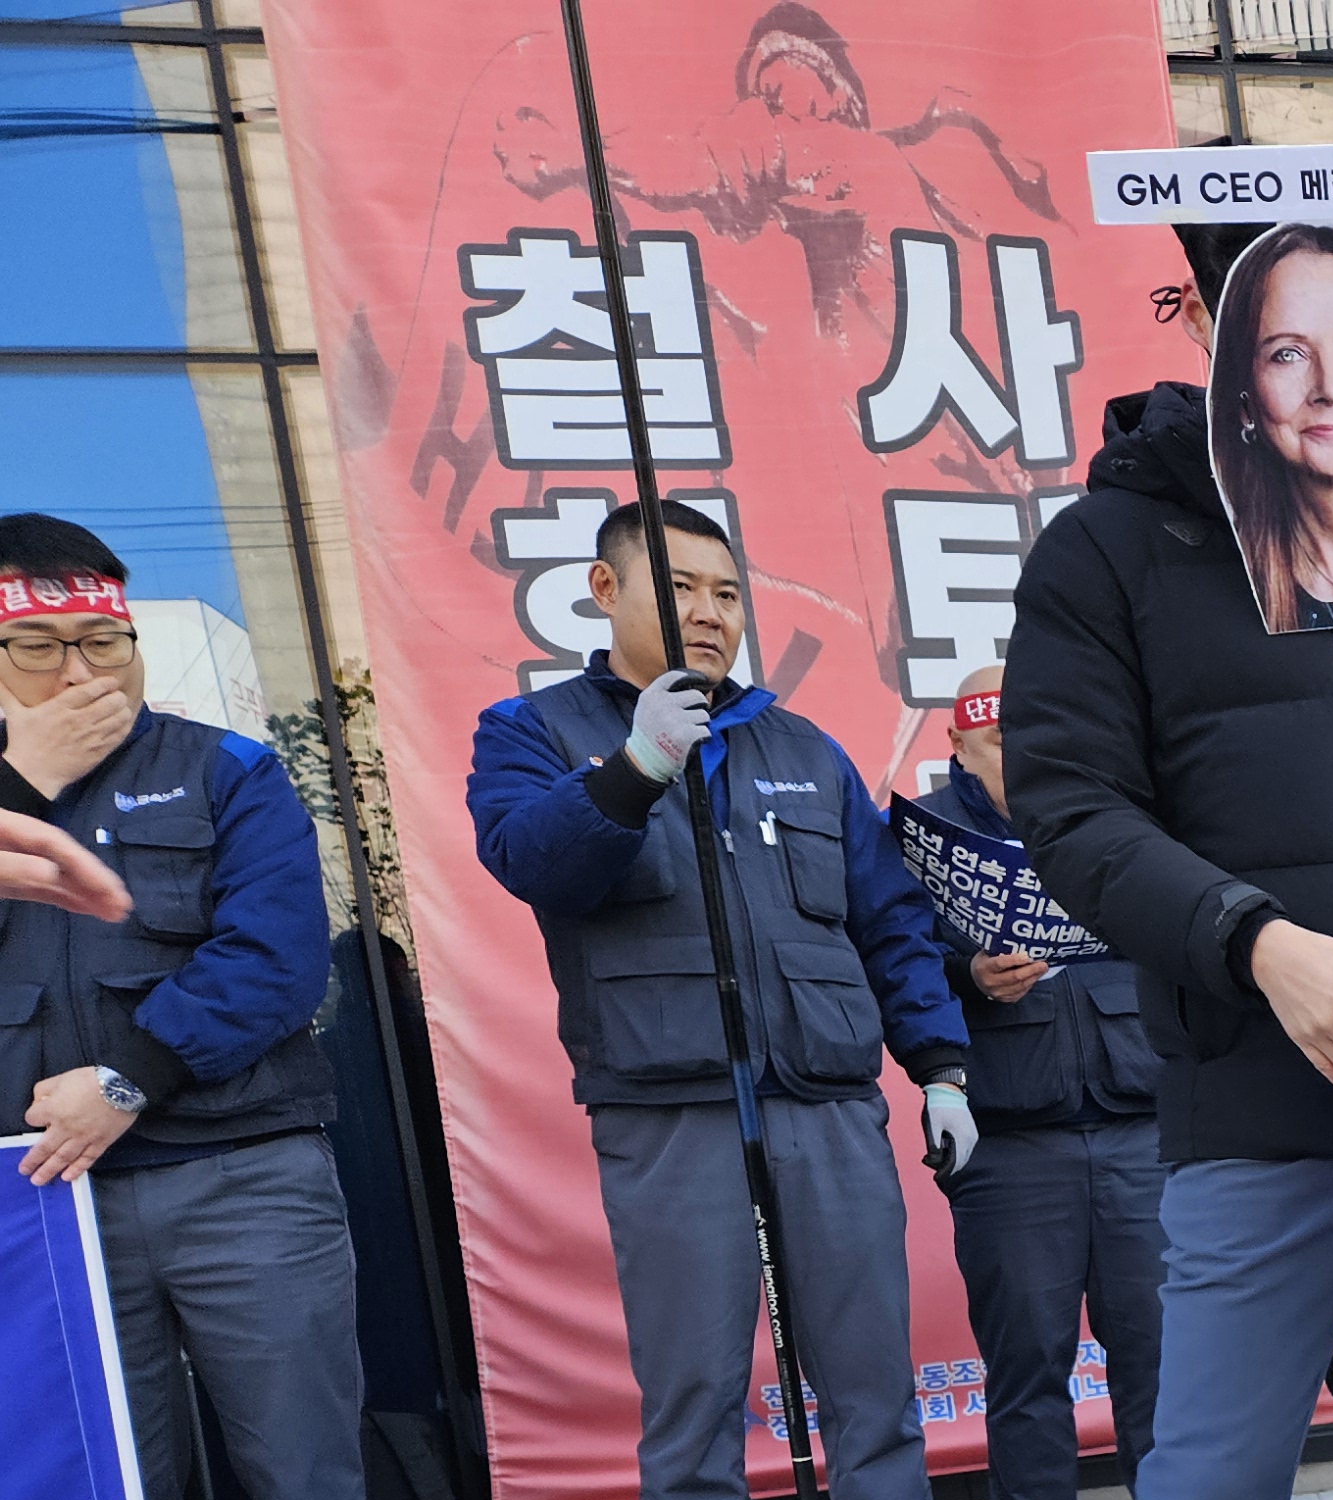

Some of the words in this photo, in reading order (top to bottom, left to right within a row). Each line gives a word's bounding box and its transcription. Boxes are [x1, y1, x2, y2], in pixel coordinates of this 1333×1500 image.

[1117, 173, 1181, 206] GM
[1200, 170, 1283, 203] CEO
[903, 816, 943, 855] 3년
